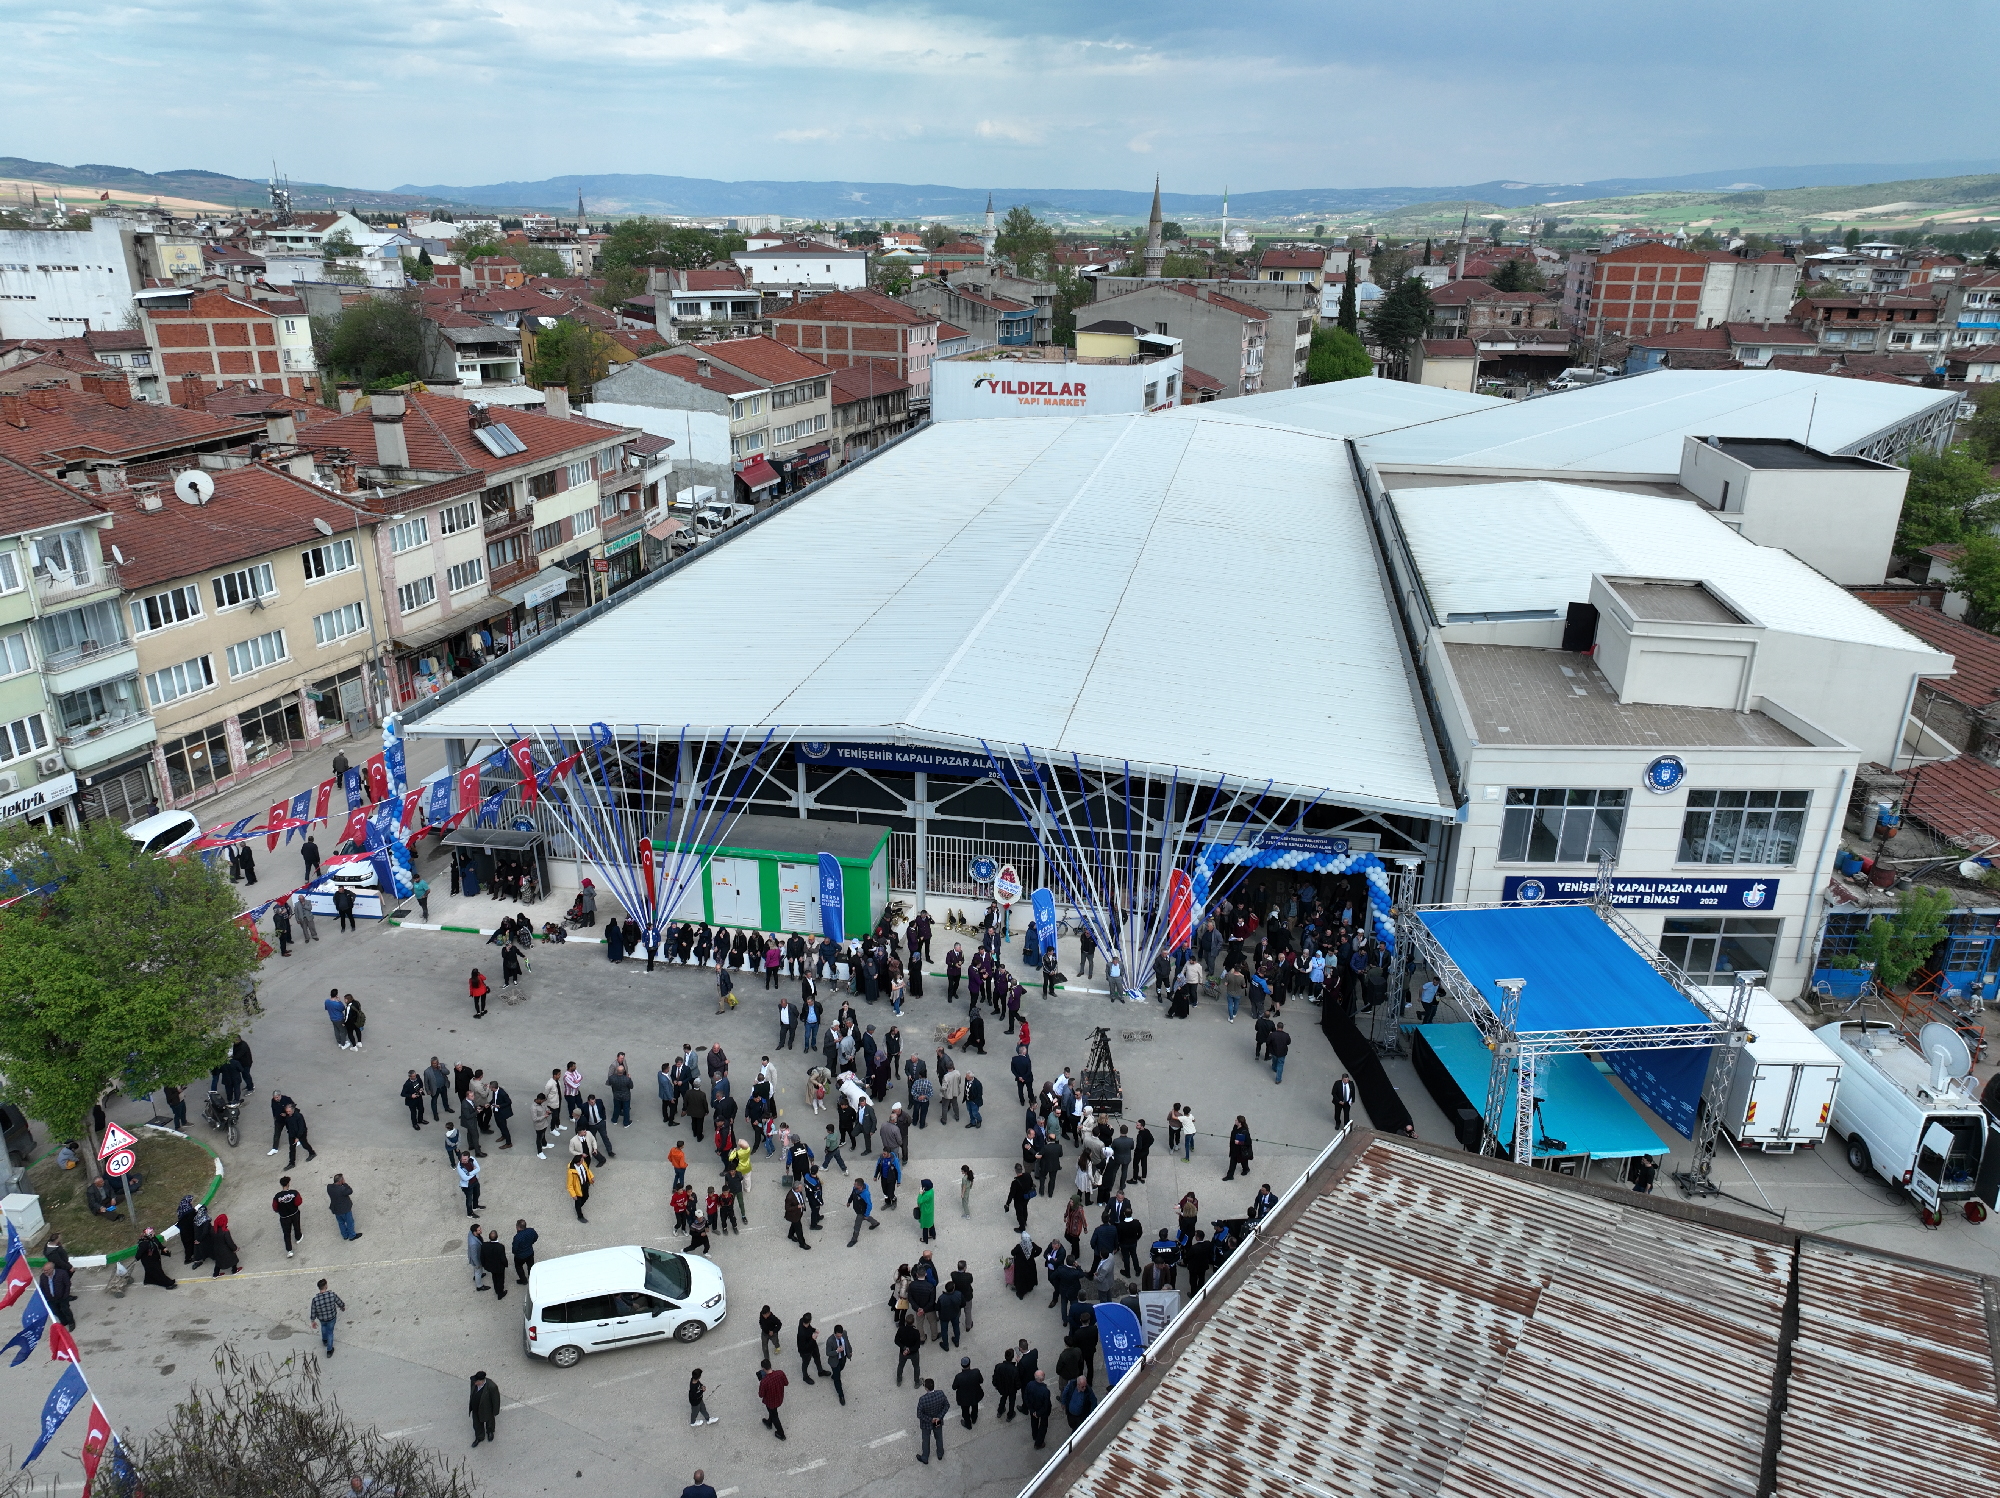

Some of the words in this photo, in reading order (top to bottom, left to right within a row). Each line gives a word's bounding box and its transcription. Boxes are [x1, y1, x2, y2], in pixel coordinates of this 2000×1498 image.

[987, 380, 1087, 396] YILDIZLAR
[1018, 397, 1040, 405] YAPI
[1043, 398, 1087, 406] MARKET
[837, 747, 893, 761] YENİŞEHİR
[895, 752, 933, 764] KAPALI
[935, 757, 970, 767] PAZAR
[1616, 883, 1656, 893] KAPALI
[1657, 884, 1693, 893] PAZAR
[1693, 884, 1728, 894] ALANI
[1642, 893, 1680, 904] BİNASI
[112, 1155, 129, 1171] 30
